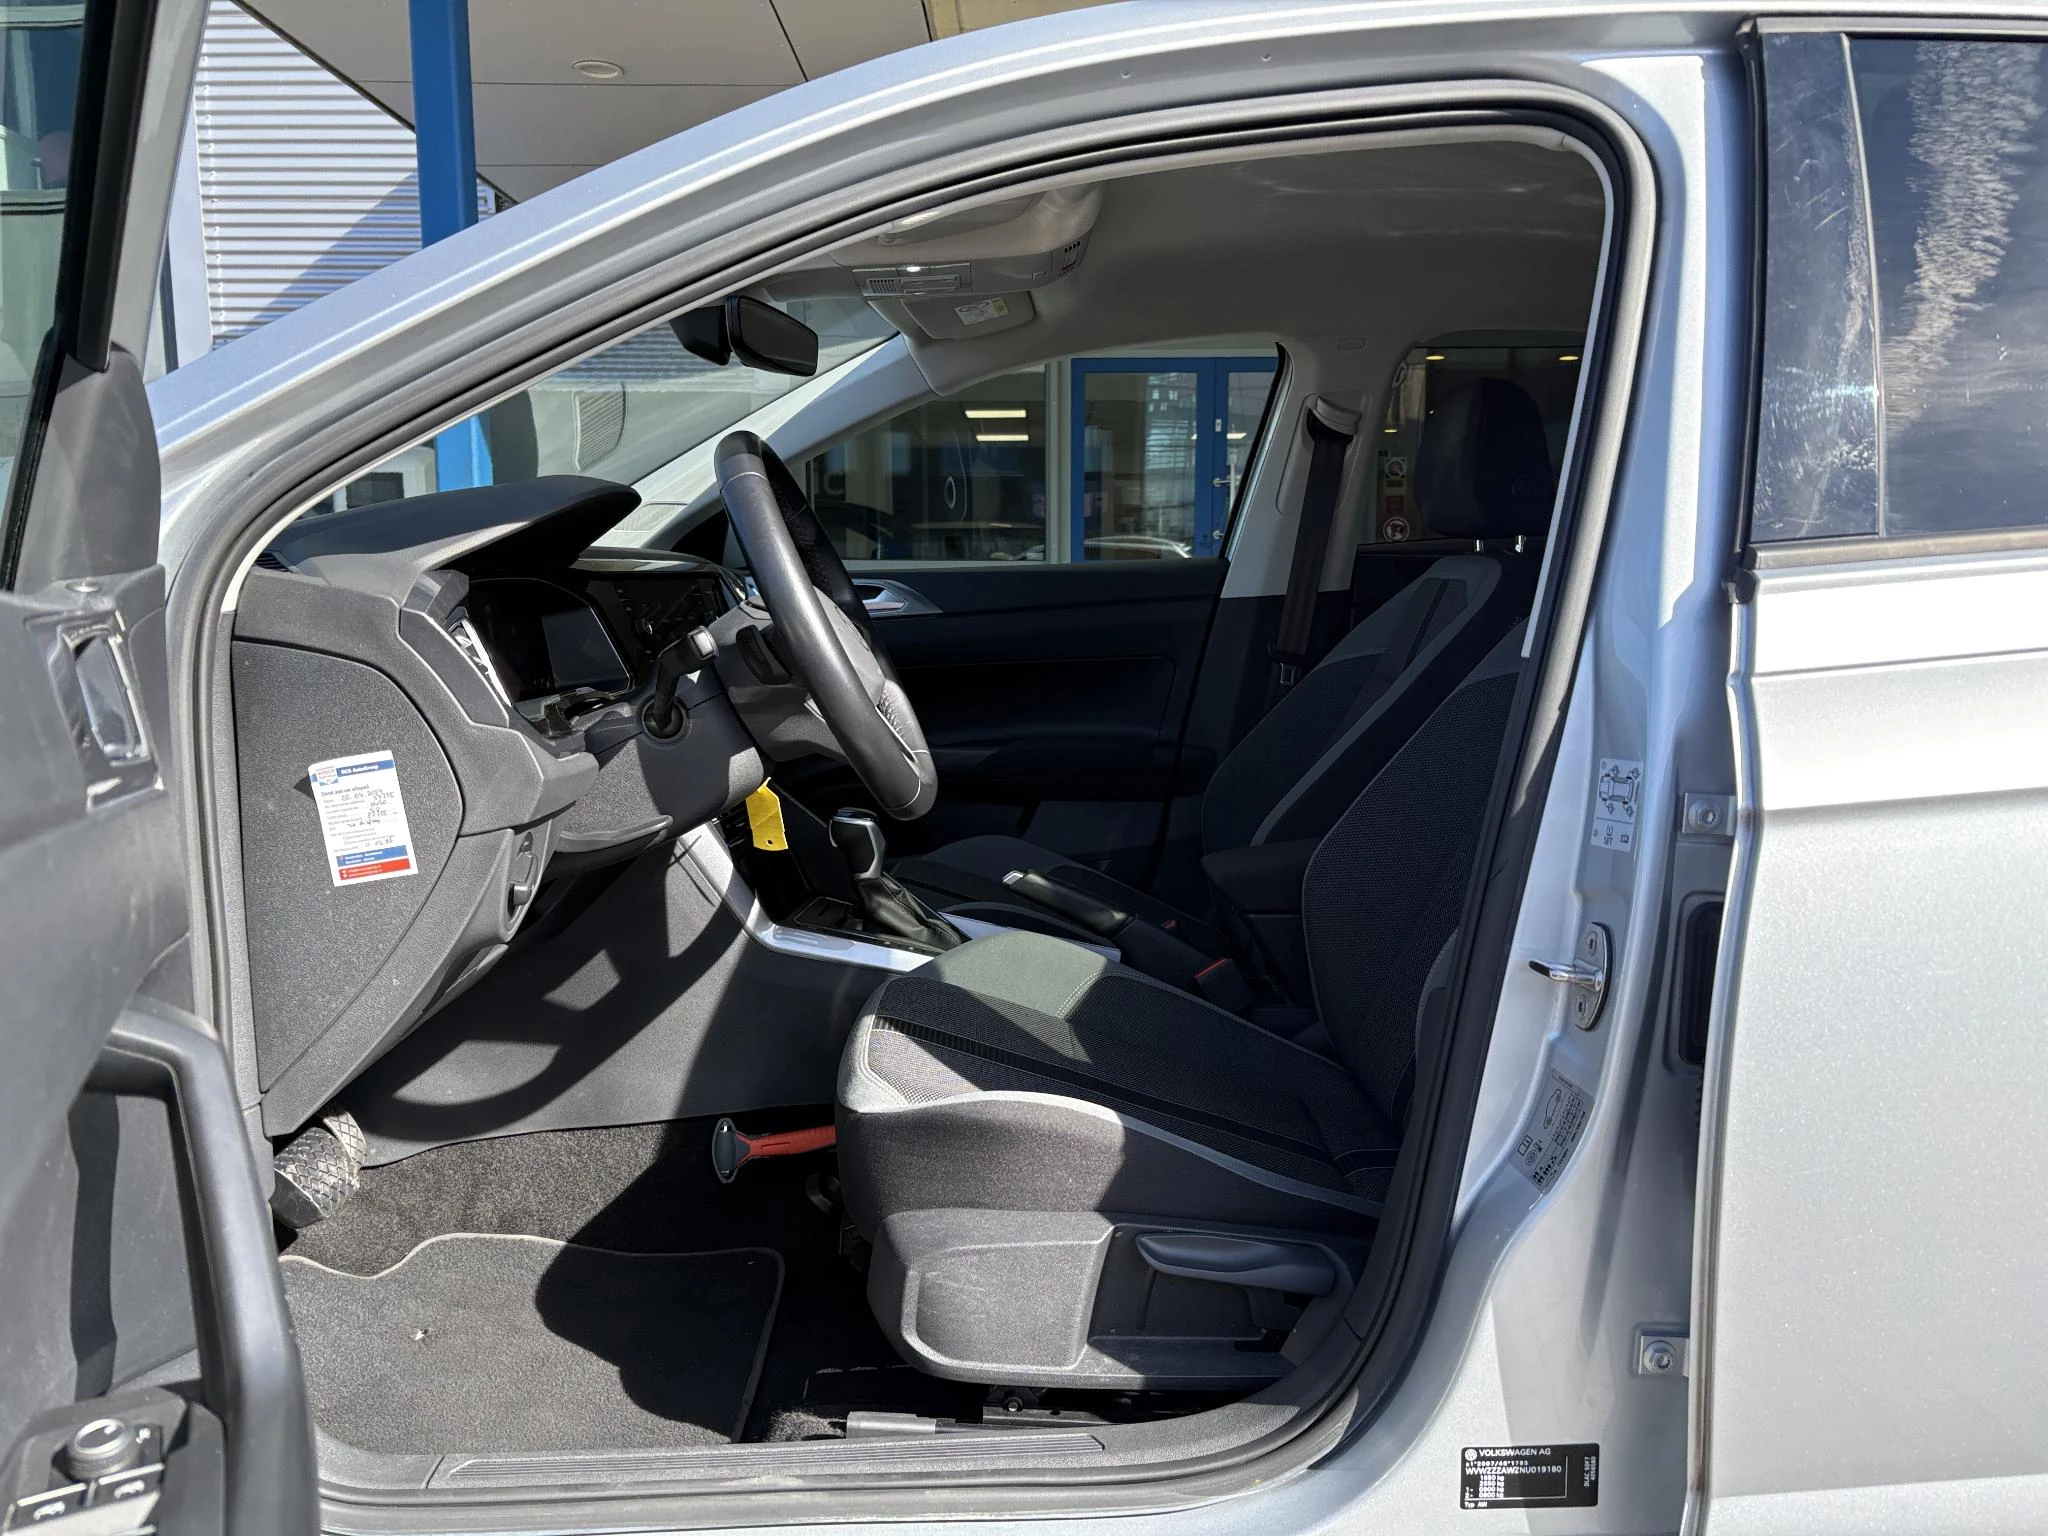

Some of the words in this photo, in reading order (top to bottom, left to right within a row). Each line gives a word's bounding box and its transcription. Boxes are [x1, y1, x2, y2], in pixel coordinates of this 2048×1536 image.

[1479, 1448, 1537, 1457] VOLKSWAGEN
[1539, 1447, 1551, 1455] AG
[1465, 1465, 1562, 1475] WVWZZZAWZNU019180
